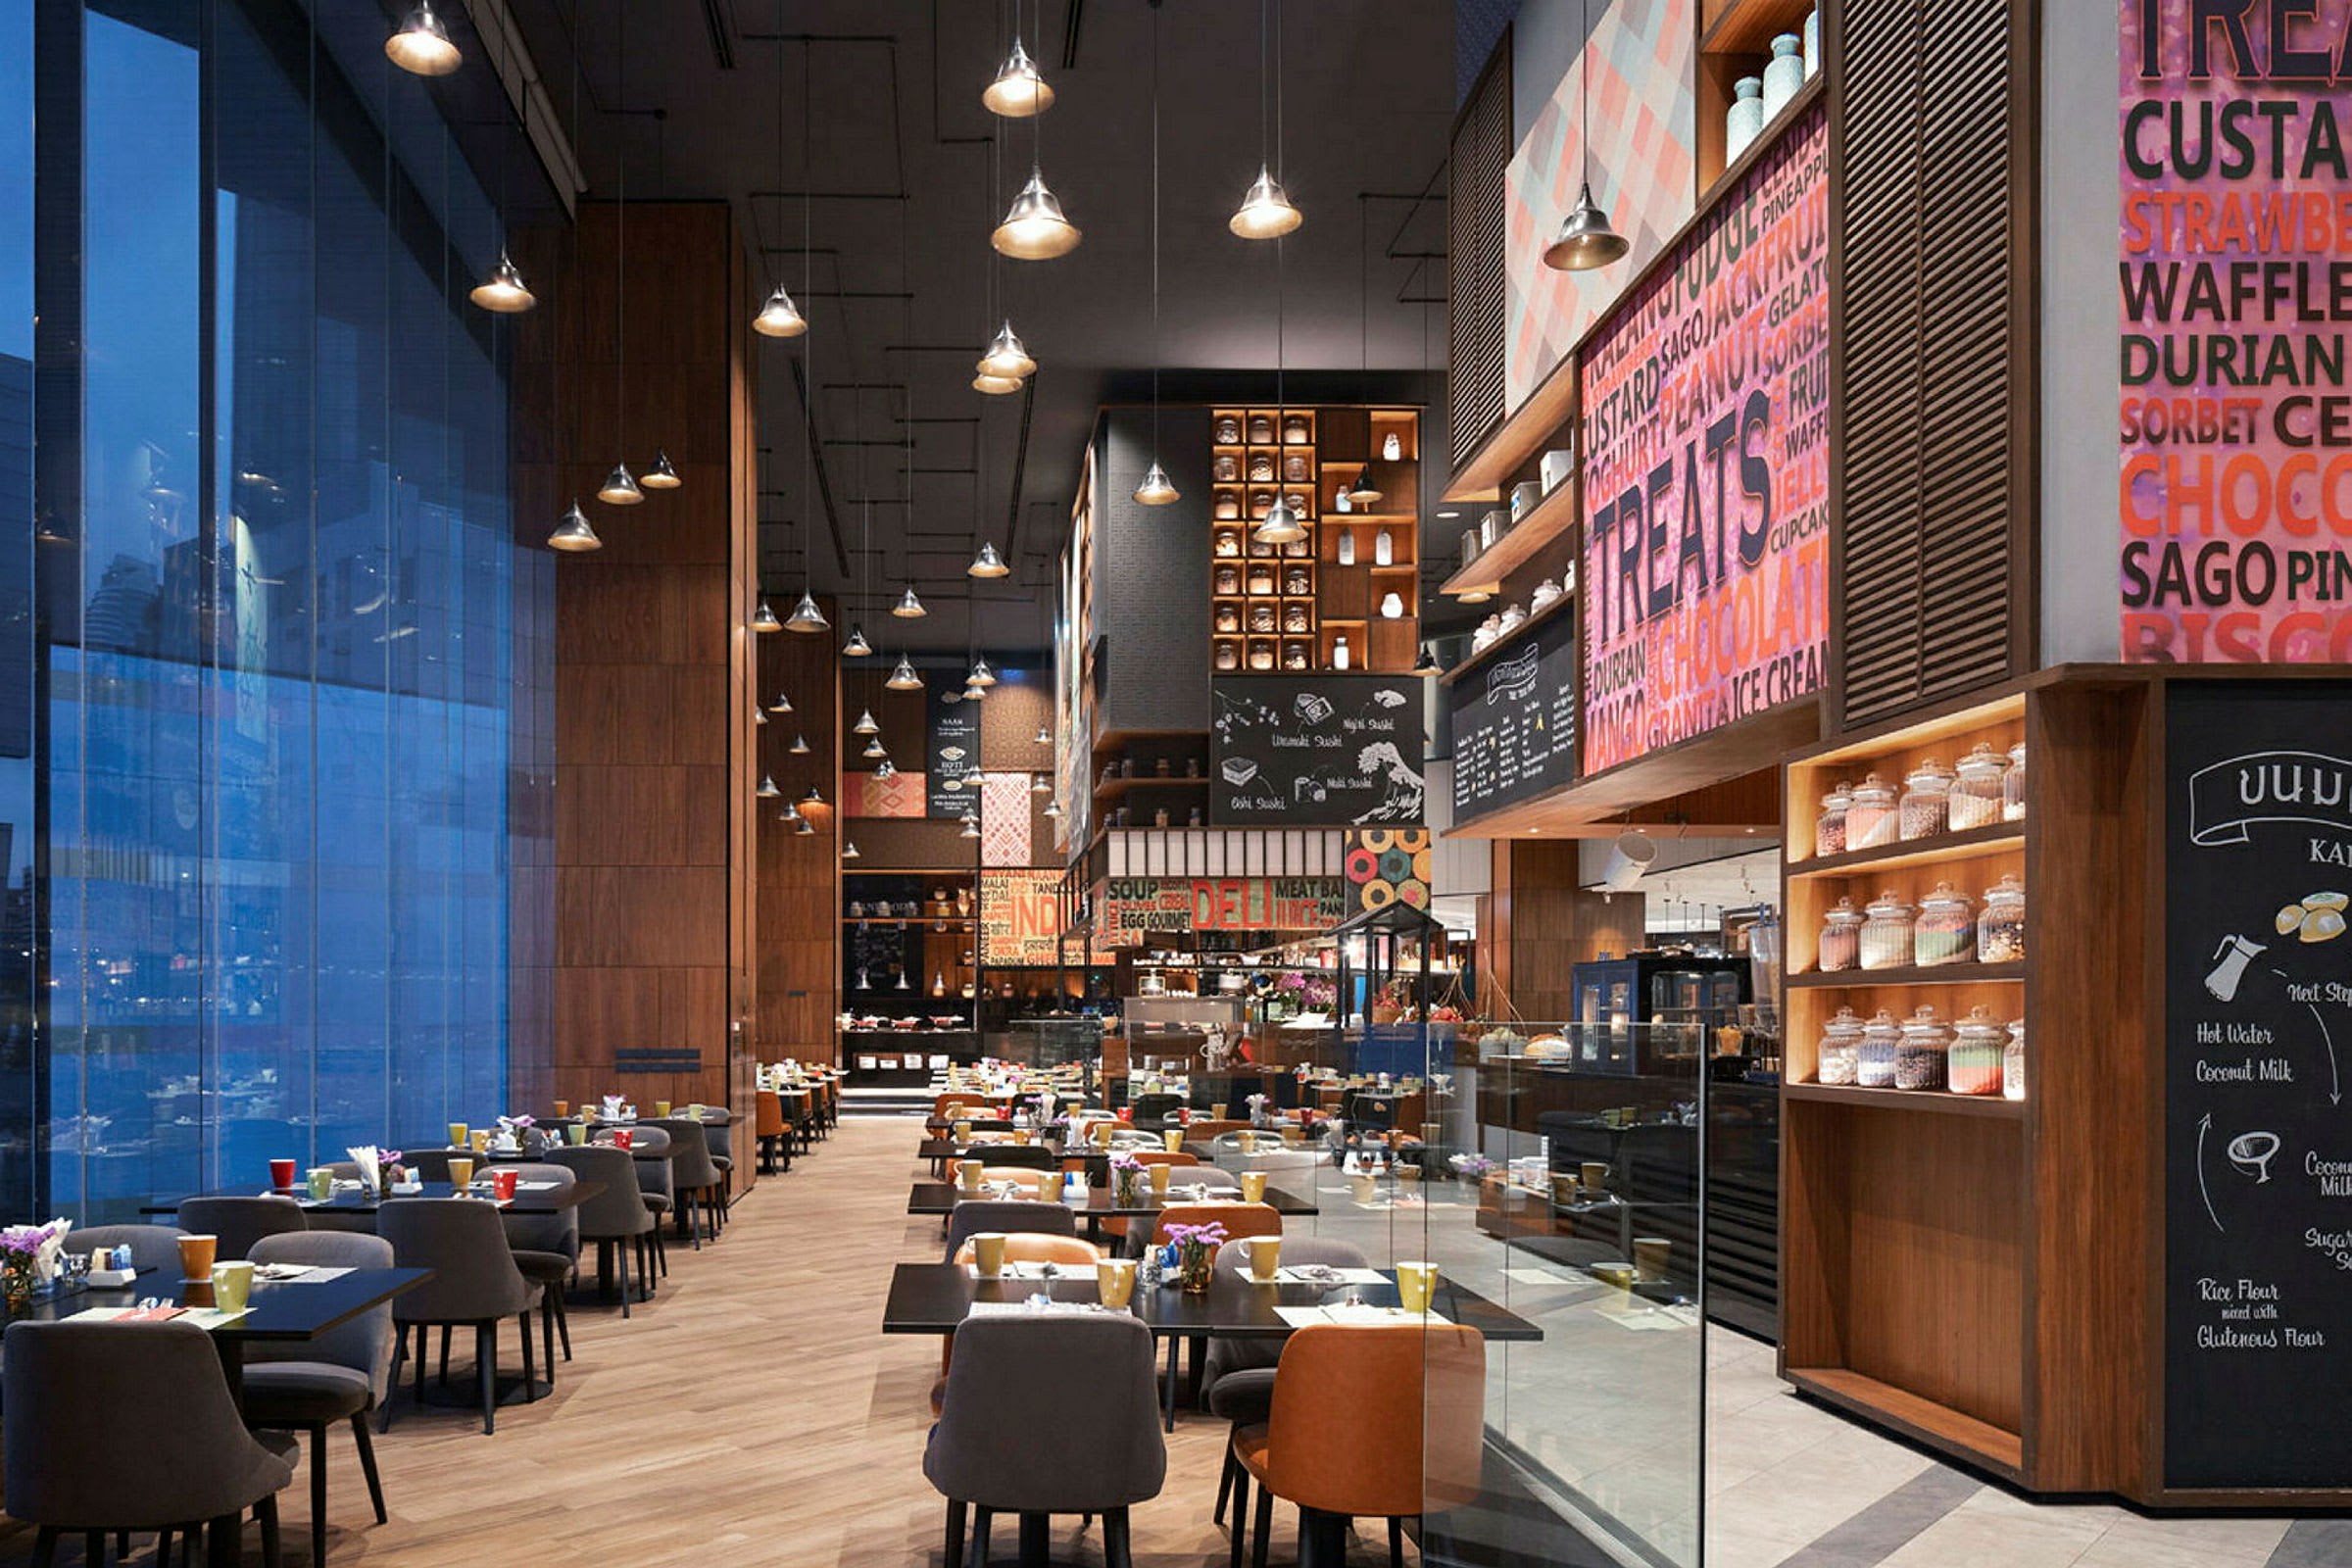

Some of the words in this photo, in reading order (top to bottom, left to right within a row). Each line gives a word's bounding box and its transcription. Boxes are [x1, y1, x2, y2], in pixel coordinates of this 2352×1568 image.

[2124, 100, 2348, 179] CUSTA
[2120, 262, 2352, 321] WAFFLE
[1661, 309, 1704, 374] SAGO
[2120, 334, 2343, 386] DURIAN
[1660, 311, 1765, 449] PEANUT
[2120, 397, 2262, 444] SORBET
[1592, 389, 1772, 648] TREATS
[2122, 541, 2277, 607] SAGO
[1594, 638, 1646, 700] DURIAN
[1733, 667, 1761, 721] ICE
[1368, 718, 1395, 730] Sushi
[1314, 735, 1343, 747] Sushi
[1348, 777, 1372, 789] Sushi
[2240, 764, 2352, 813] ขนม
[1256, 798, 1286, 810] Sushi
[1108, 879, 1158, 900] SOUP
[1275, 881, 1316, 899] MEAT
[1120, 900, 1156, 911] OLIVES
[1192, 879, 1272, 929] DELI
[1120, 912, 1146, 929] EGG
[1148, 911, 1192, 930] GOURMET
[994, 946, 1020, 957] OKRA
[1025, 953, 1058, 965] GHEE
[2287, 983, 2322, 1002] Next
[2197, 1023, 2223, 1044] Hot
[2228, 1023, 2274, 1045] Water
[2196, 1059, 2254, 1083] Coconut
[2259, 1059, 2293, 1083] Milk
[2197, 1277, 2232, 1300] Rice
[2238, 1279, 2280, 1300] Flour
[2222, 1304, 2249, 1320] mixed
[2254, 1304, 2278, 1319] with
[2197, 1325, 2278, 1348] Glutenous
[2284, 1327, 2326, 1348] Flour
